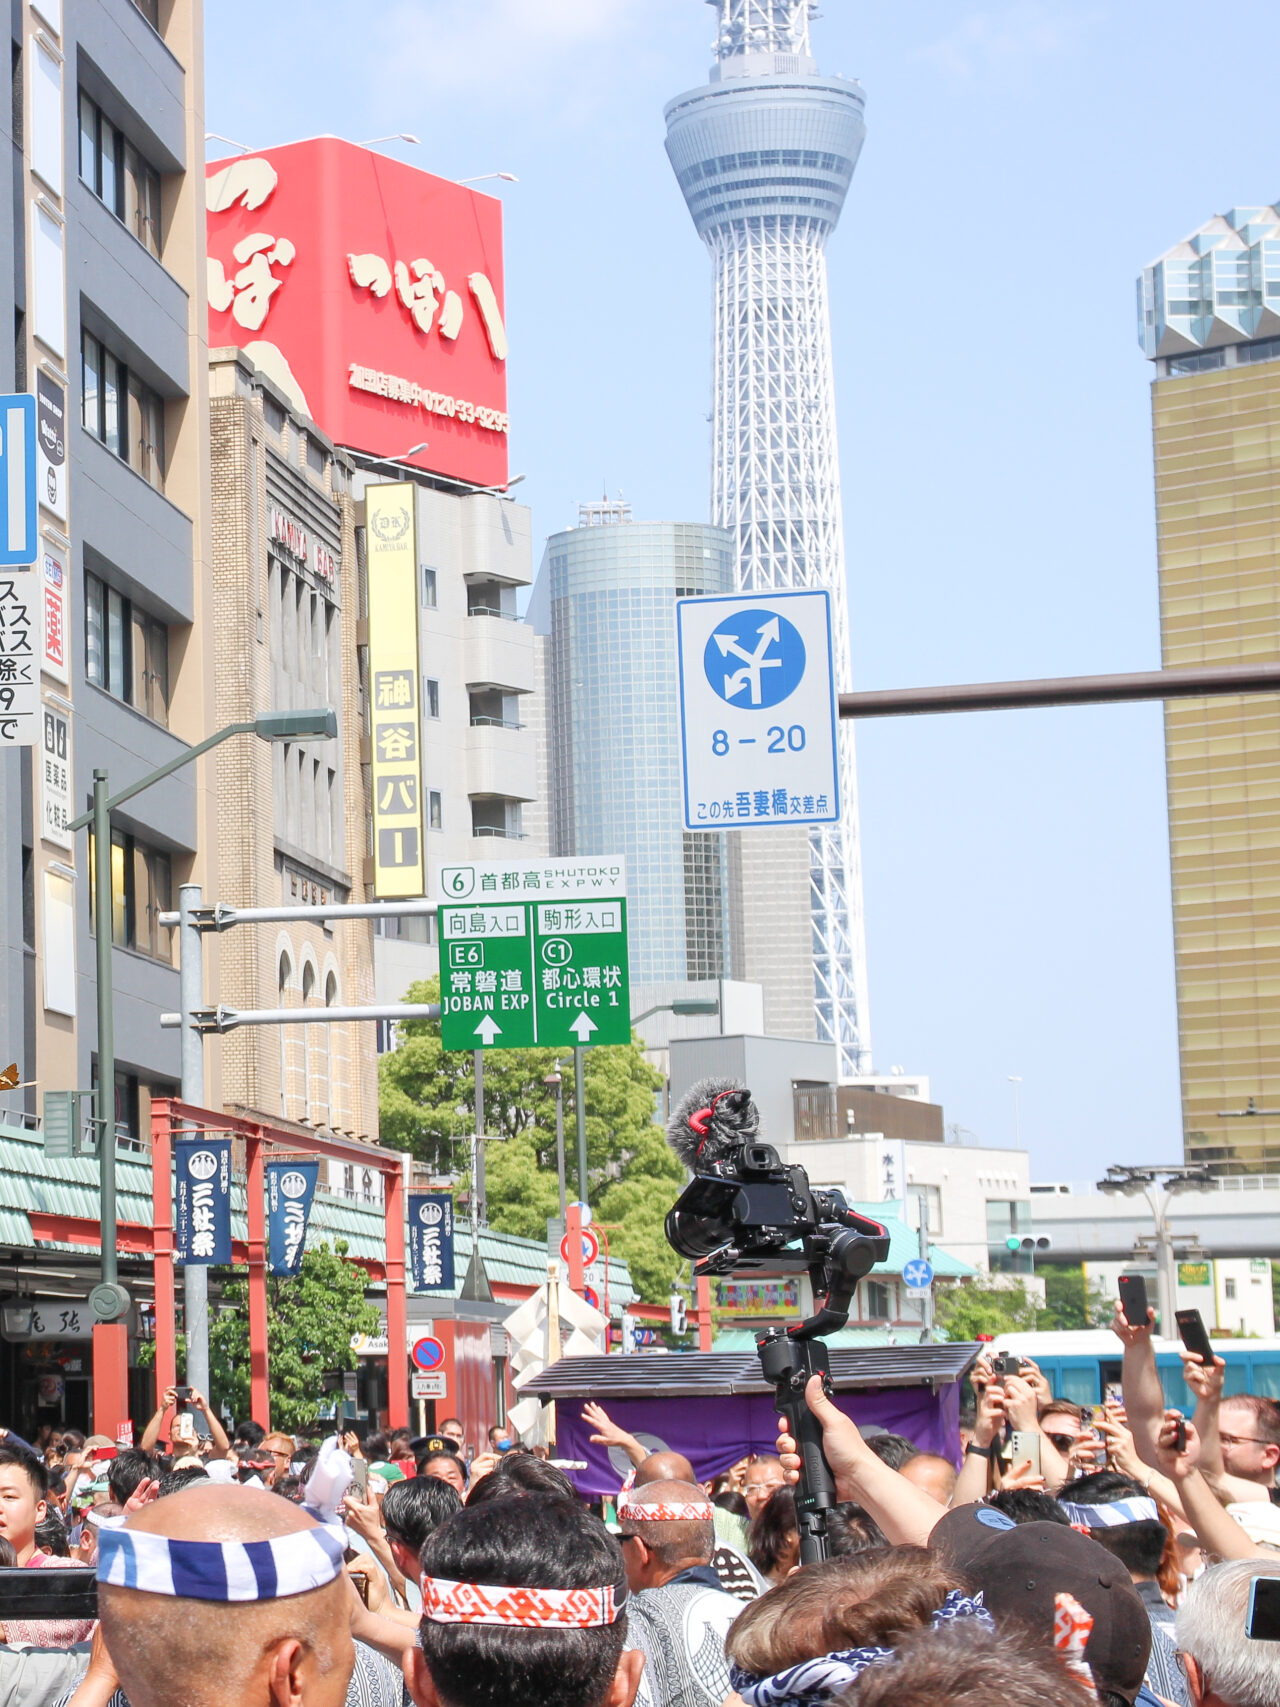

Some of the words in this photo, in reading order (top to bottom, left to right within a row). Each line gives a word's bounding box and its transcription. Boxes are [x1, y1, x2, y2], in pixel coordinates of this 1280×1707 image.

[347, 253, 510, 361] つぼ八
[271, 508, 307, 563] KAMIYA
[313, 544, 336, 584] BAR
[45, 759, 67, 792] 医薬品
[378, 675, 414, 864] 神谷バー
[45, 800, 68, 831] 化粧品
[697, 788, 829, 820] この先吾妻橋交差点
[452, 872, 465, 892] 6
[480, 871, 541, 892] 首都高
[544, 867, 620, 878] SHUTOKO
[449, 912, 519, 935] 向島入口
[544, 908, 615, 931] 駒形入口
[455, 947, 479, 964] E6
[547, 944, 565, 960] C1
[450, 969, 523, 994] 常磐道
[542, 965, 622, 991] 都心環状
[444, 995, 494, 1015] JOBAN
[501, 994, 529, 1010] EXP
[546, 991, 600, 1008] Circle
[609, 991, 620, 1007] 1
[192, 1183, 216, 1257] 三社祭
[422, 1226, 443, 1285] 三社祭
